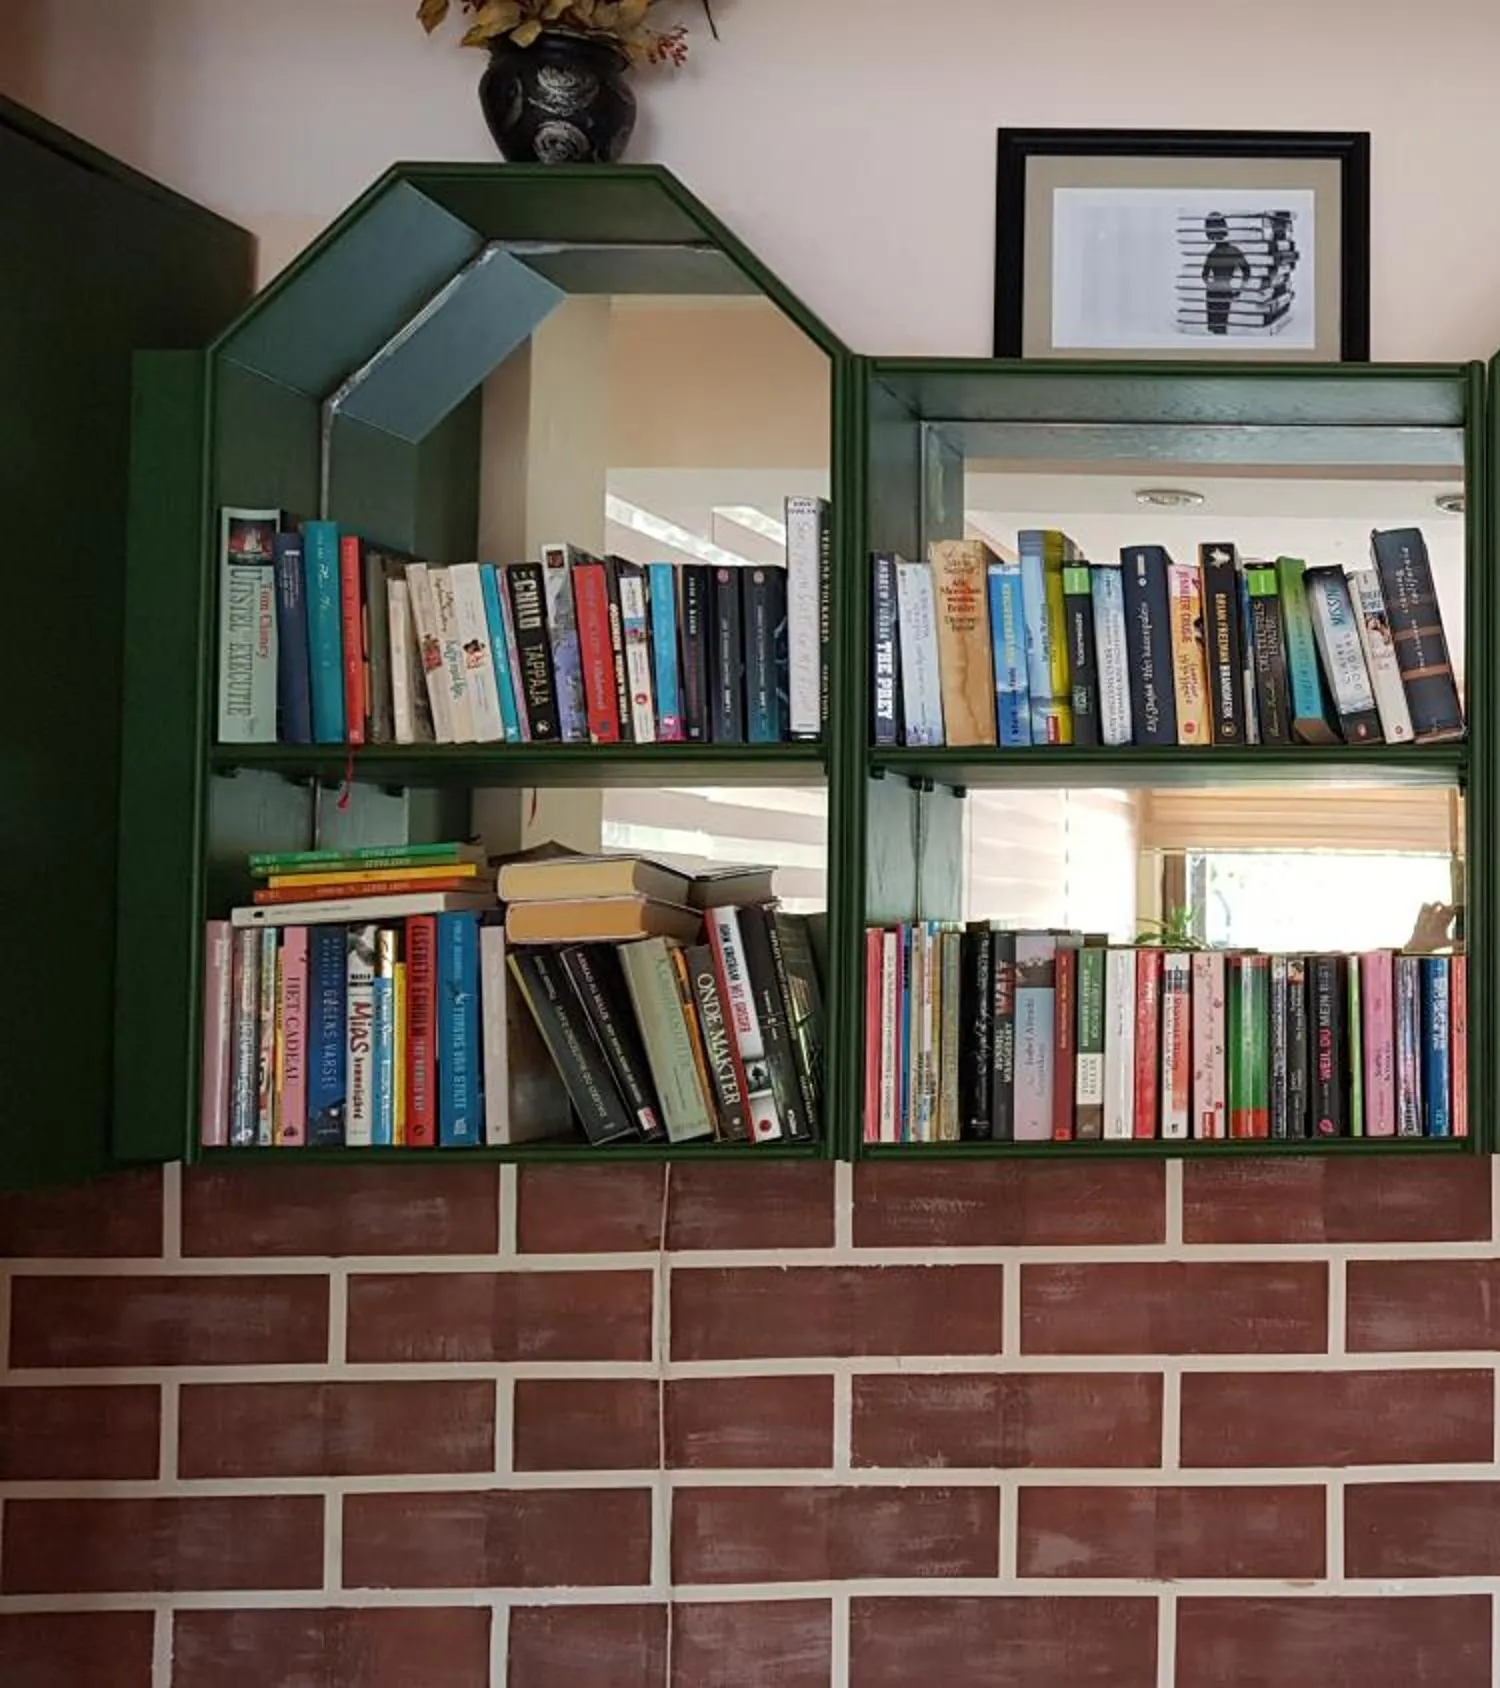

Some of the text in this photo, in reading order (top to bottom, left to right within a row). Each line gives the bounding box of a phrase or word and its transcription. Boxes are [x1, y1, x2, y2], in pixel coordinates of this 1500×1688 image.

[522, 644, 549, 707] TAPPAJA
[877, 641, 892, 673] THE
[877, 677, 892, 721] PREY
[1219, 665, 1233, 719] BRANDMERK
[284, 977, 300, 1085] HET CADEAU
[350, 1002, 373, 1055] Mias
[1319, 995, 1331, 1026] MEIN
[696, 973, 741, 1106] ONDE MAKTER
[1319, 1029, 1331, 1049] DU
[1319, 1053, 1331, 1081] WEIL
